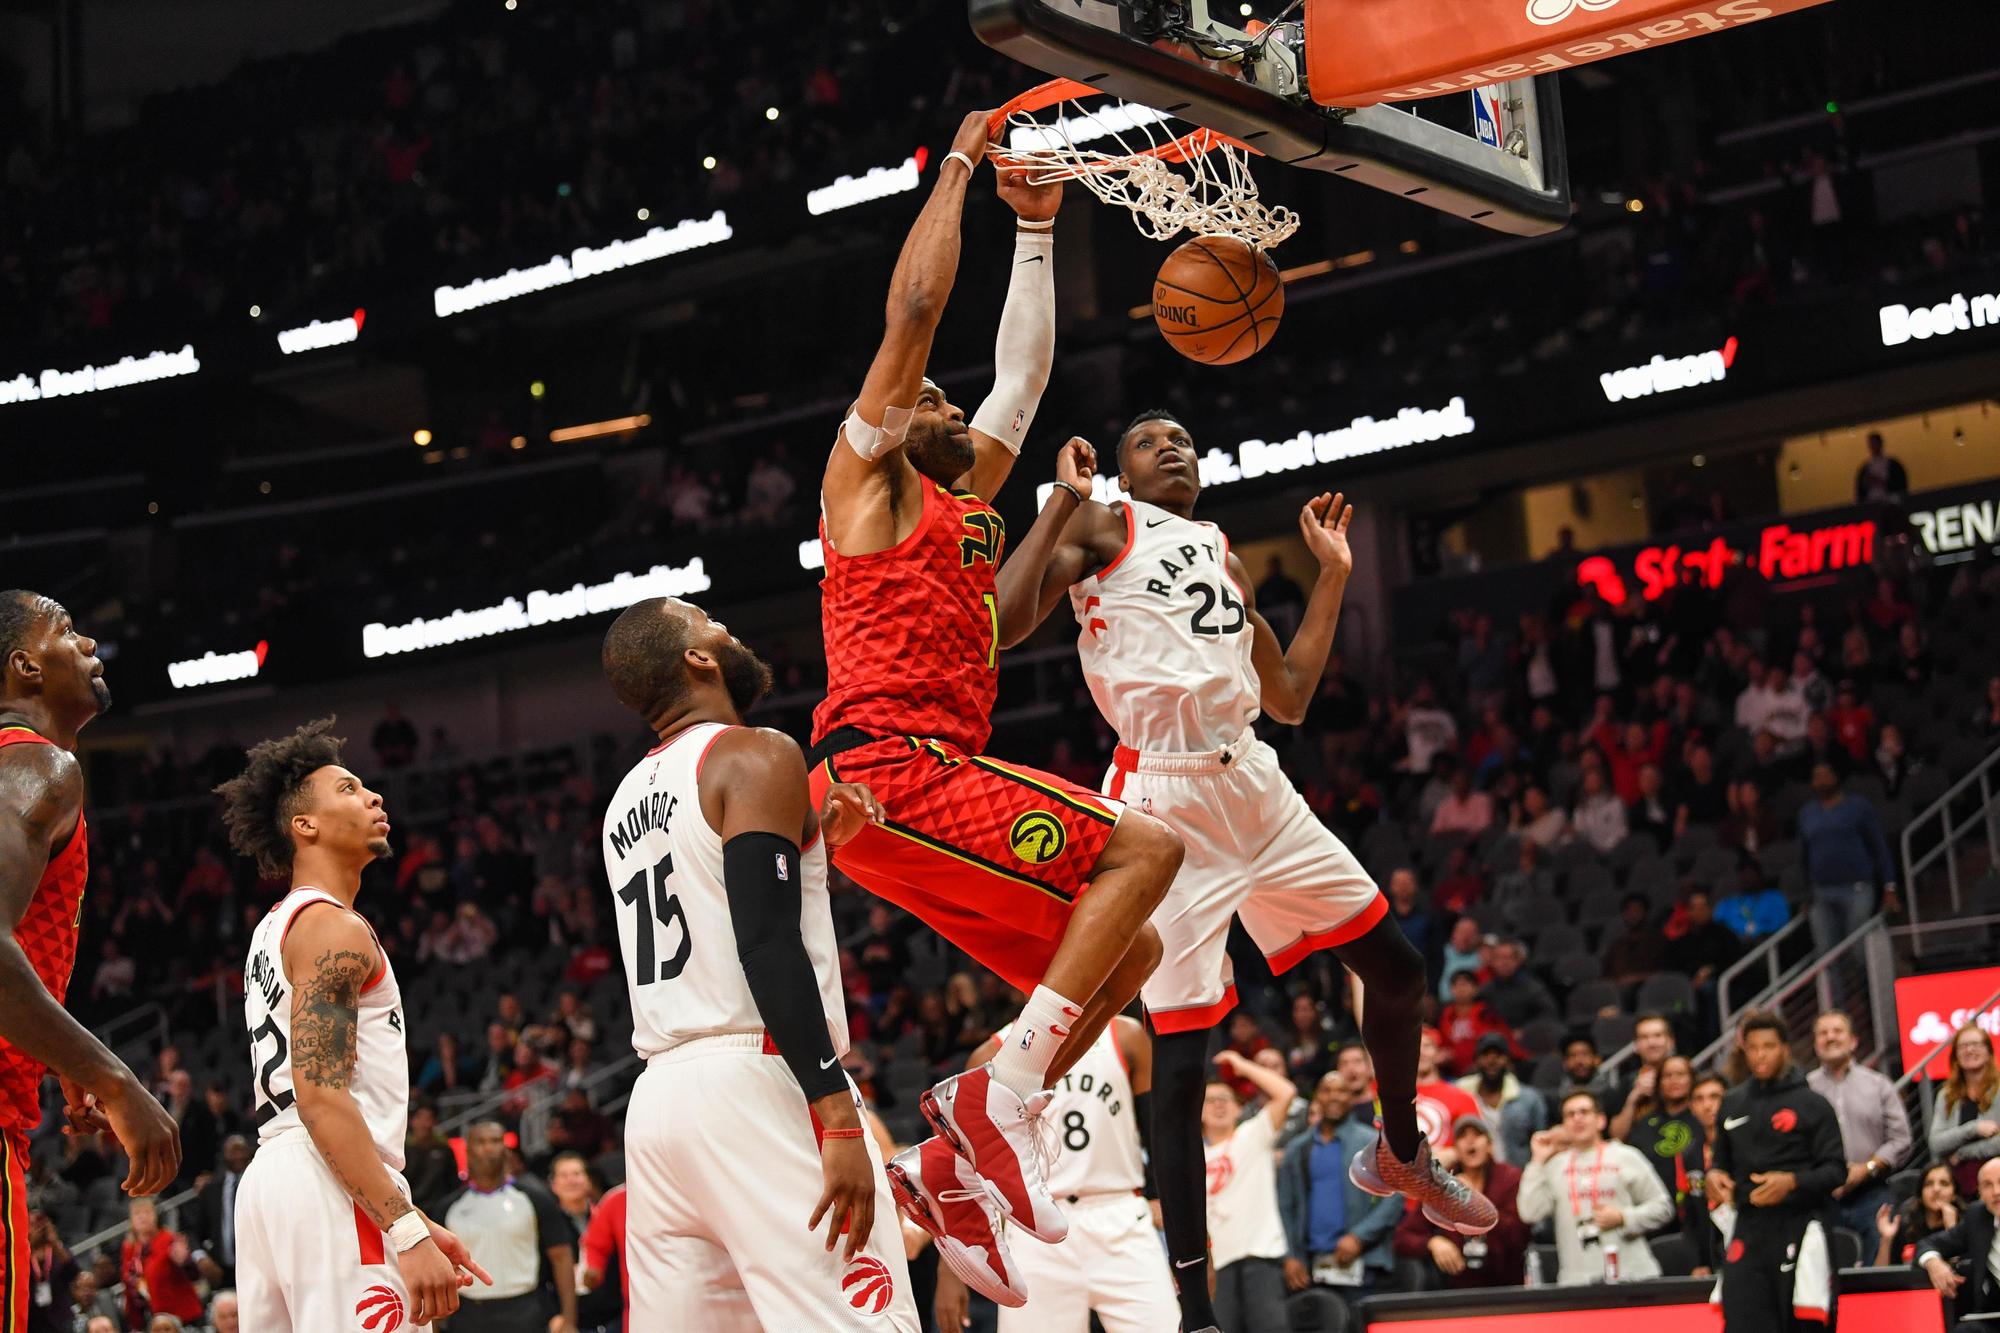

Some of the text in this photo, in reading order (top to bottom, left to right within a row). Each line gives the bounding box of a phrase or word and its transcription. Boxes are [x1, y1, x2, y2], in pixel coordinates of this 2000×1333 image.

[1147, 543, 1218, 597] RAPT
[1759, 519, 1876, 581] Farm
[1184, 582, 1244, 634] 25
[609, 791, 678, 861] MONROE
[1053, 1073, 1121, 1116] TORS
[1064, 1110, 1090, 1151] 8
